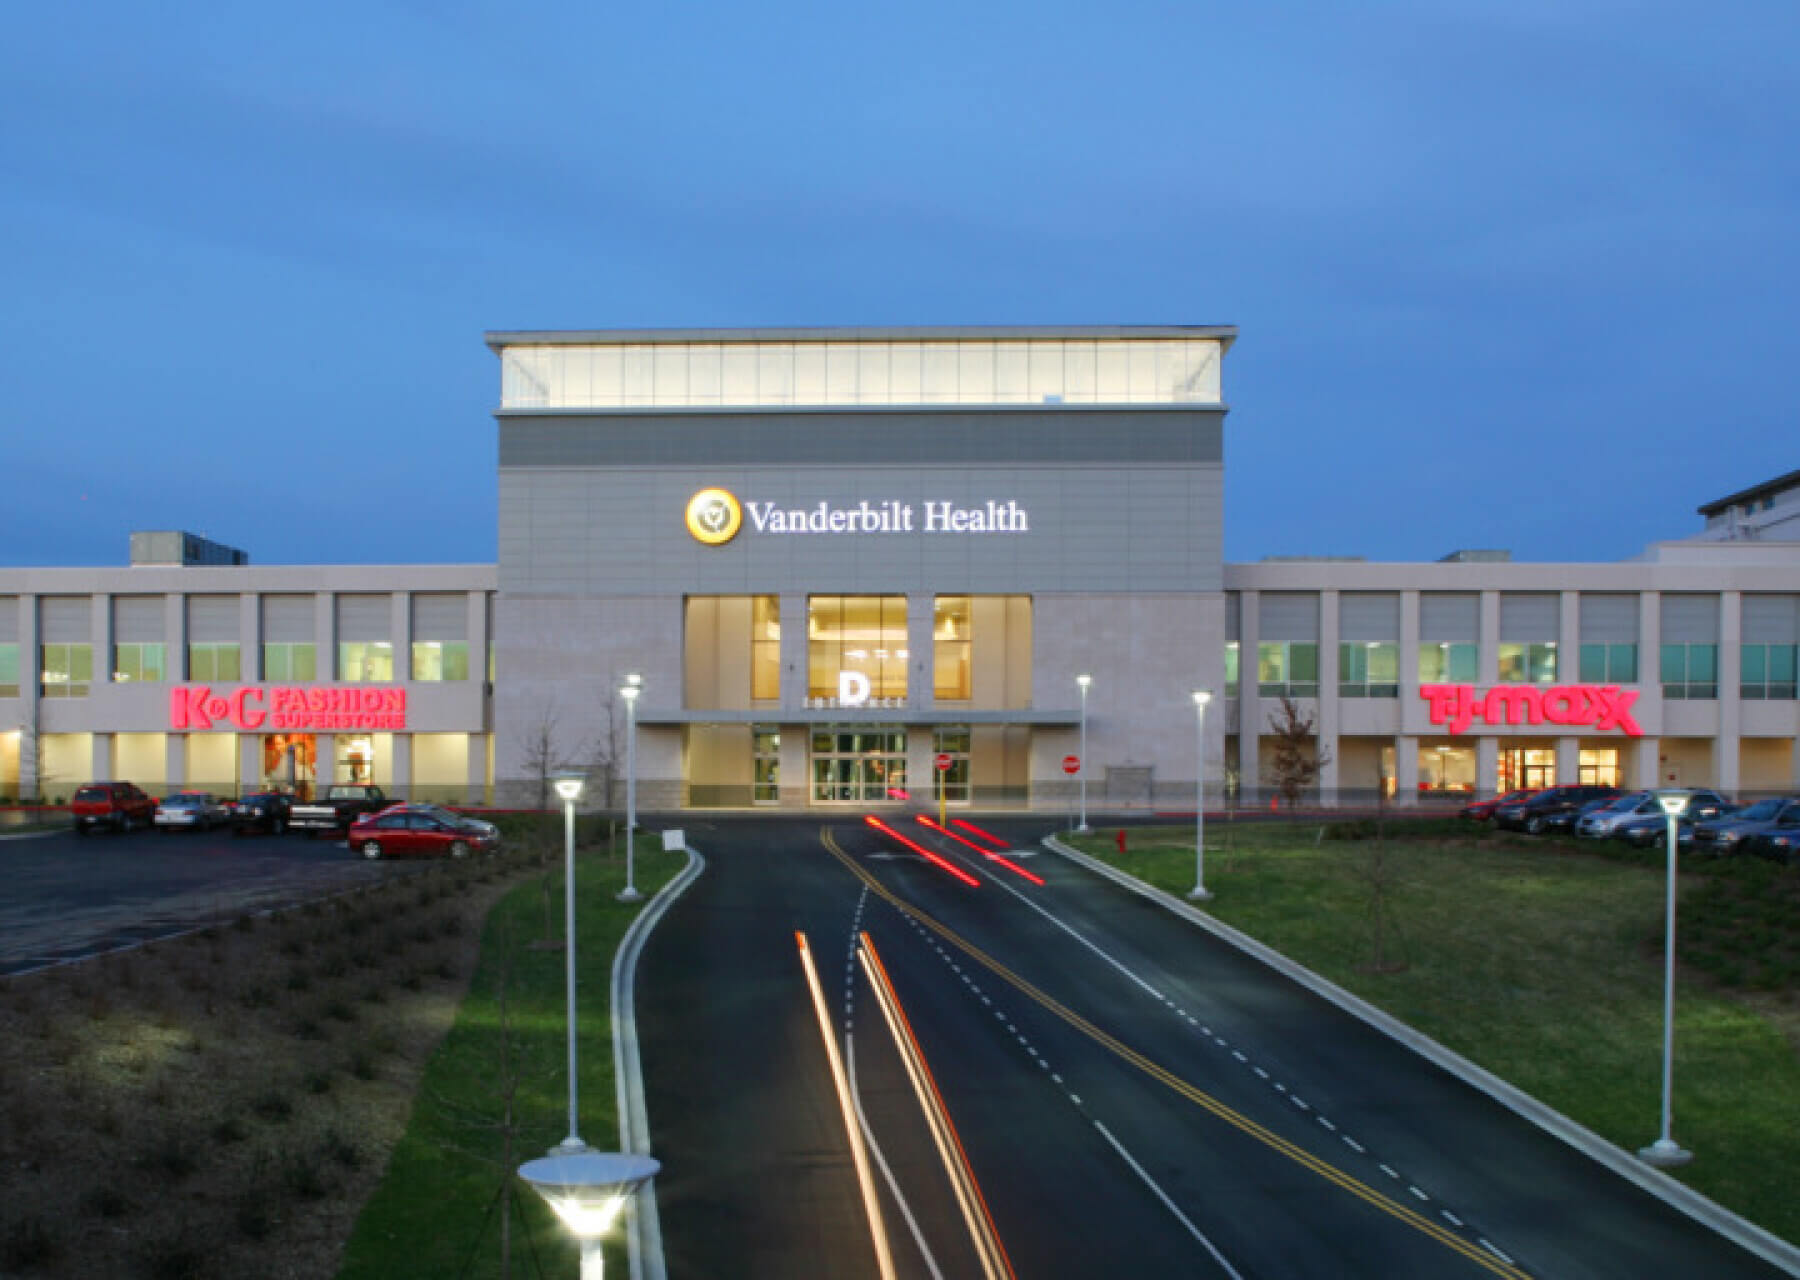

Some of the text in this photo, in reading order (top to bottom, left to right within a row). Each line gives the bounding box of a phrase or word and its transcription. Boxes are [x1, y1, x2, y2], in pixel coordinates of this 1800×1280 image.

[746, 499, 1029, 533] Vanderbilt Health
[270, 687, 407, 712] FASHION
[838, 671, 870, 705] D
